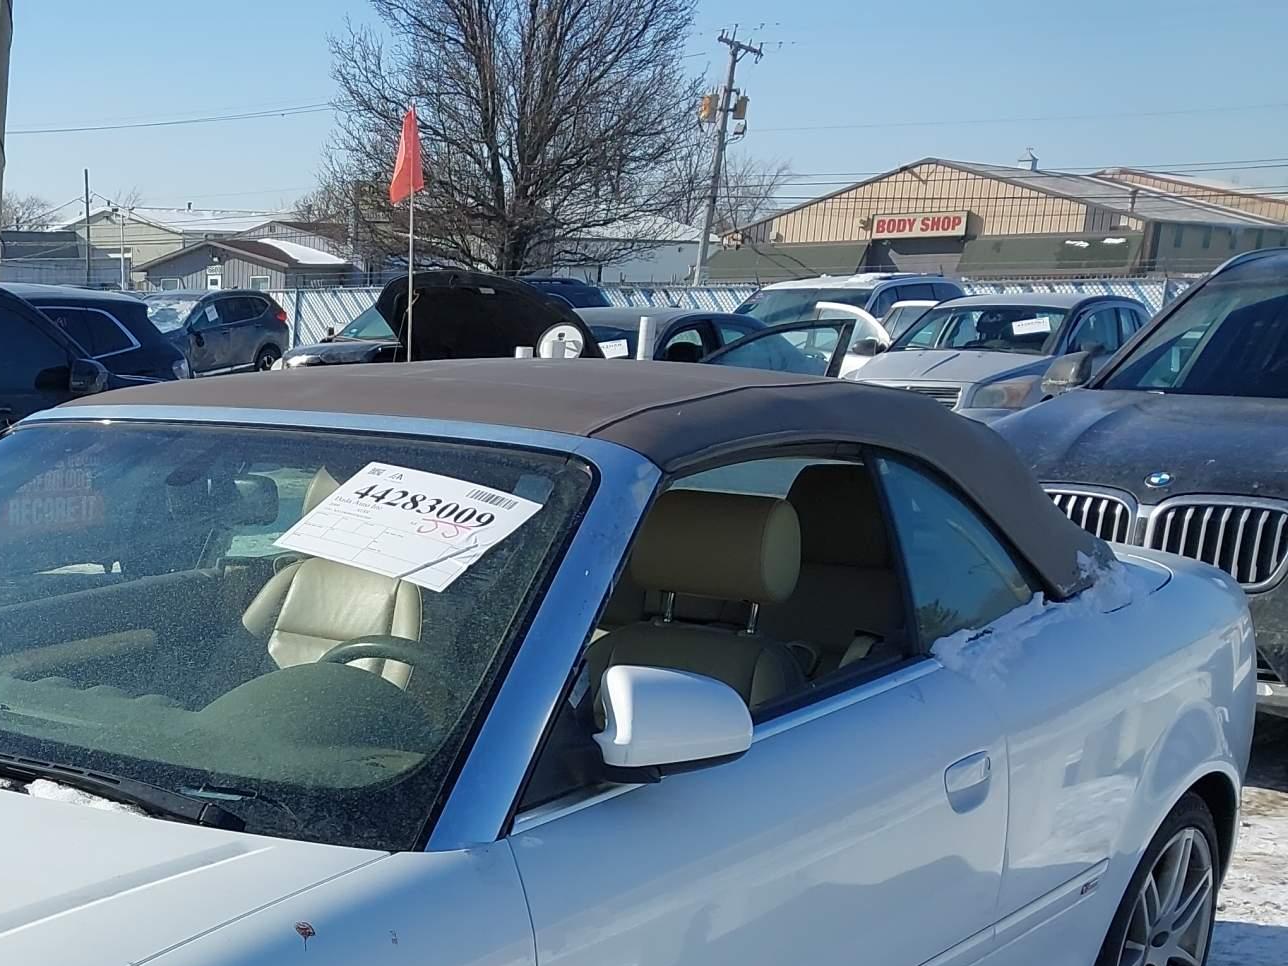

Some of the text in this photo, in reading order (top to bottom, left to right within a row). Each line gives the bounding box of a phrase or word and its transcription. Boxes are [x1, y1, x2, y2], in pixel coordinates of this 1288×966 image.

[875, 215, 962, 234] BODY SHOP
[353, 484, 496, 529] 44283009
